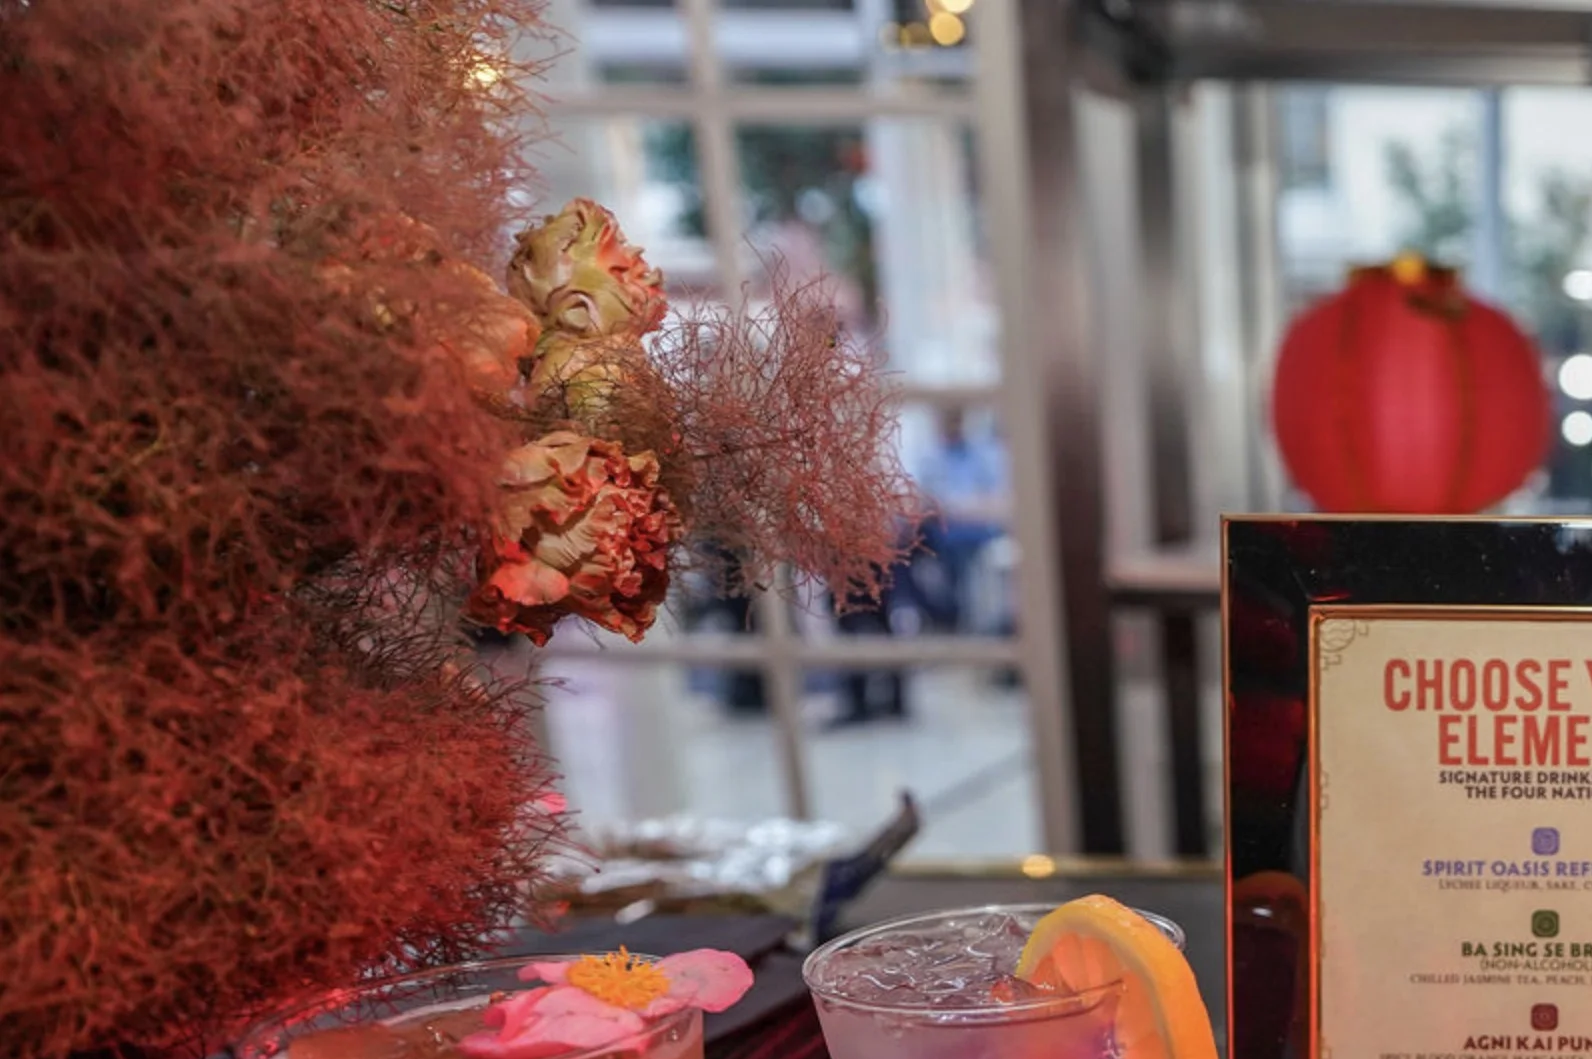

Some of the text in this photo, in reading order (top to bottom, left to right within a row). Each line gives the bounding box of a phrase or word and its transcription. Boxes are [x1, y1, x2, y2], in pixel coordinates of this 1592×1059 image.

[1383, 658, 1571, 712] CHOOSE
[1439, 771, 1532, 785] SIGNATURE
[1465, 786, 1496, 799] THE
[1502, 786, 1546, 799] FOUR
[1422, 860, 1486, 876] SPIRIT
[1491, 860, 1550, 876] OASIS
[1461, 942, 1487, 957] BA
[1493, 942, 1537, 957] SING
[1543, 943, 1564, 957] SE
[1464, 1035, 1512, 1051] AGNI
[1516, 1036, 1552, 1051] KAI
